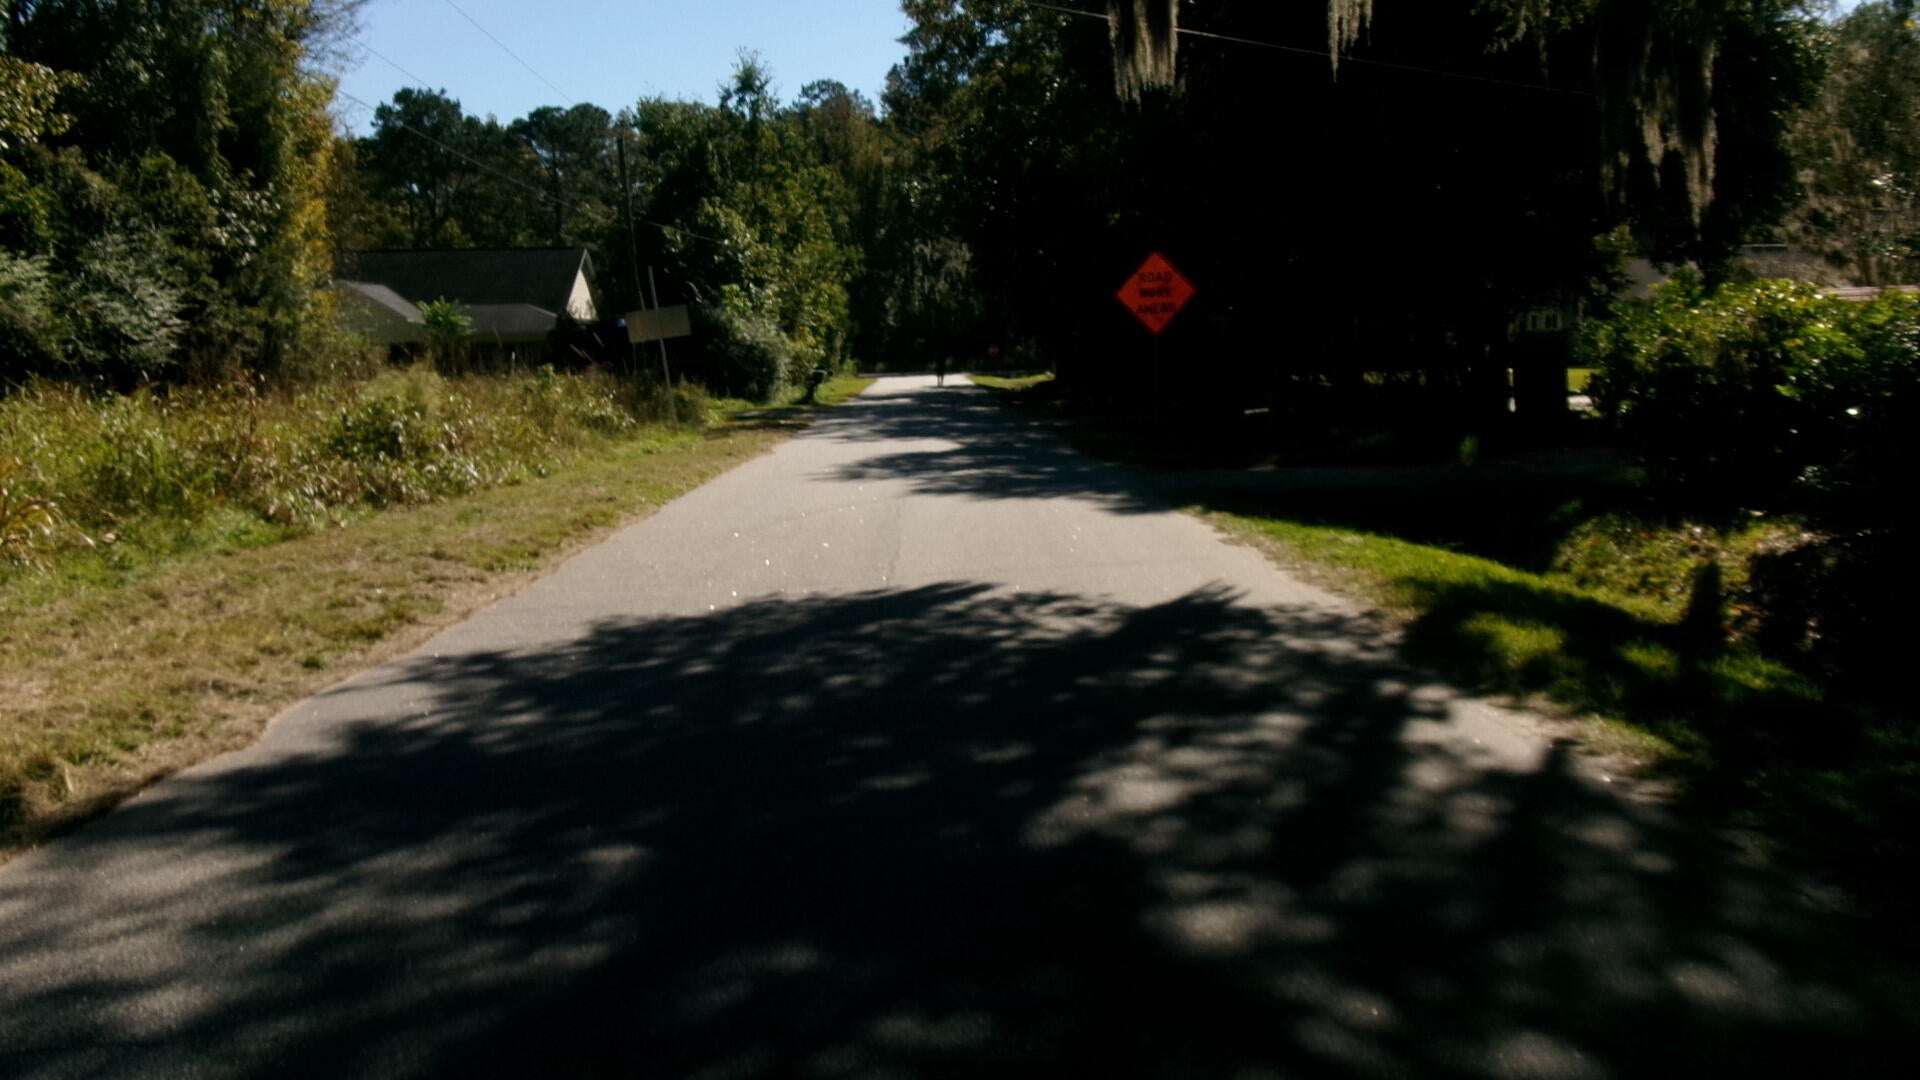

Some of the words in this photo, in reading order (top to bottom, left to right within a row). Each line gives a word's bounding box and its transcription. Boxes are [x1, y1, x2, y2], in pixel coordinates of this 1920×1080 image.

[1138, 271, 1172, 283] ROAD
[1139, 287, 1172, 298] WORK
[1136, 302, 1176, 314] AHEAD
